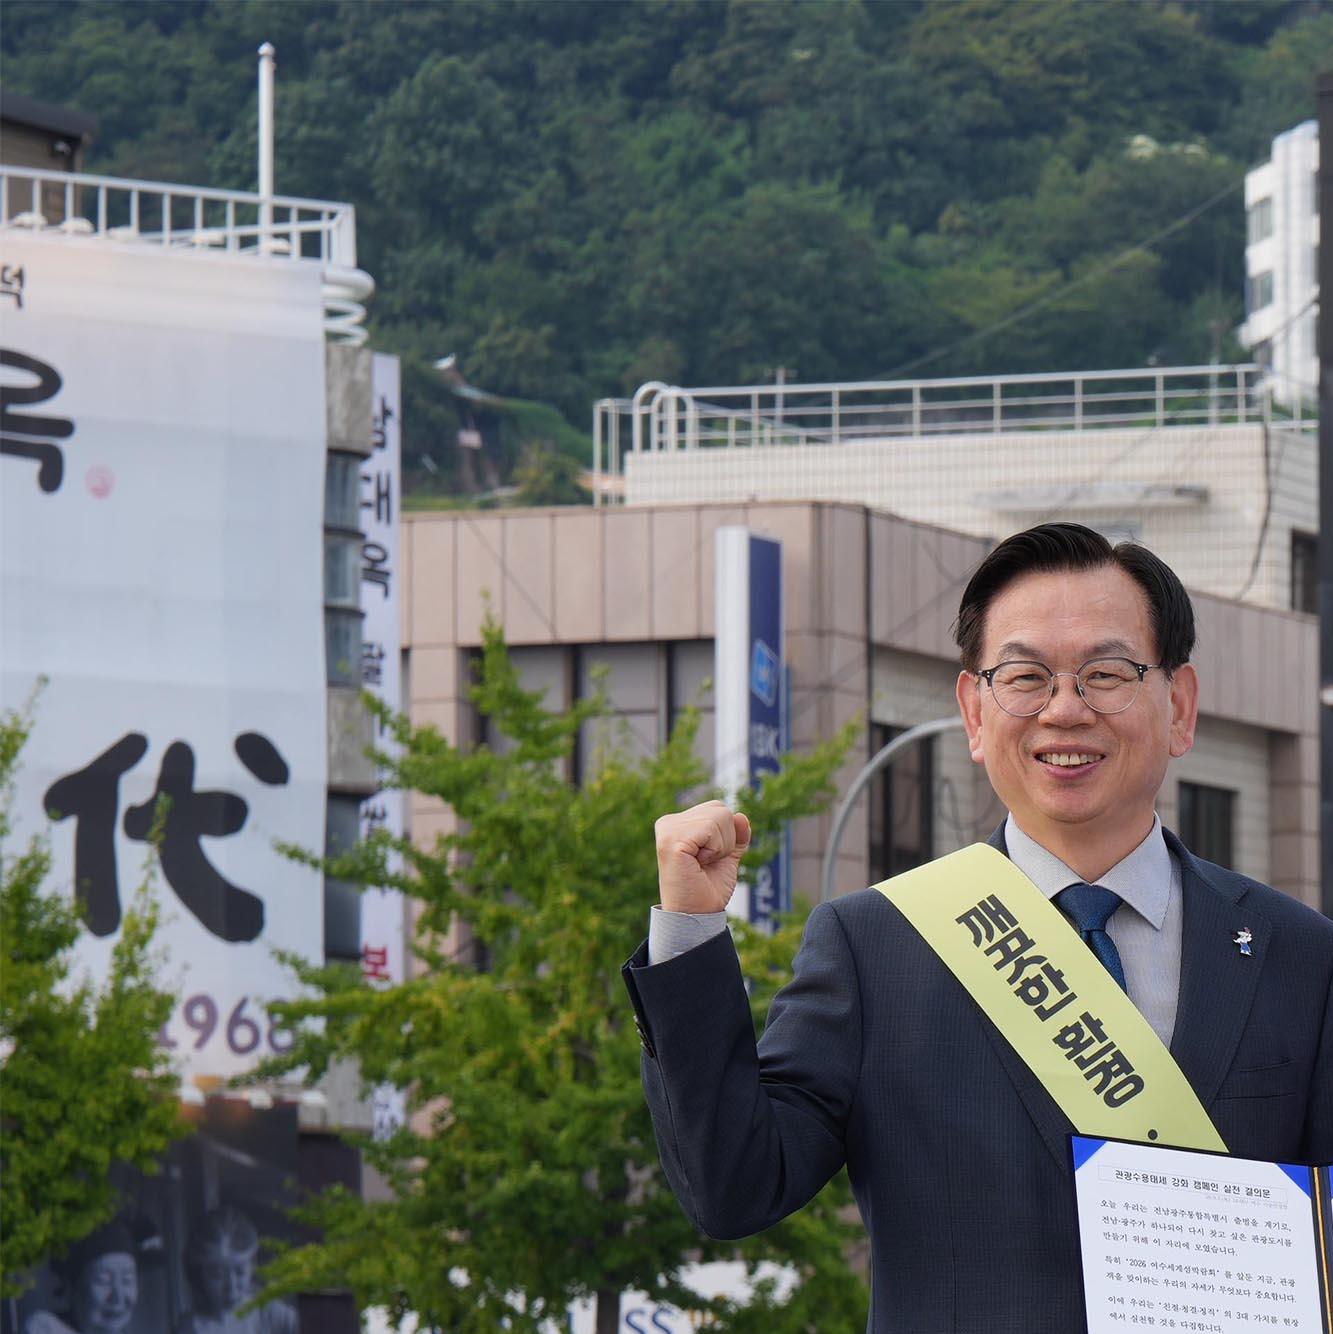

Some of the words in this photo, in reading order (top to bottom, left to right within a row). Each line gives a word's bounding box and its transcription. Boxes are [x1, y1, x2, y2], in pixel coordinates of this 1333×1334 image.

[43, 730, 290, 944] 代
[954, 894, 1078, 1022] 깨끗한
[1052, 1011, 1145, 1108] 환경
[1114, 1169, 1167, 1185] 관광수용태세
[1171, 1174, 1189, 1188] 강화
[1192, 1180, 1219, 1192] 캠페인
[1222, 1184, 1240, 1194] 실천
[1244, 1186, 1270, 1198] 결의문
[1100, 1199, 1116, 1208] 오늘
[1122, 1202, 1148, 1212] 우리는
[1153, 1206, 1228, 1223] 전남광주통합특별시
[1233, 1216, 1258, 1227] 출범을
[1102, 1231, 1128, 1242] 만들기
[1132, 1235, 1148, 1244] 위해
[1152, 1237, 1161, 1245] 이
[1165, 1239, 1190, 1249] 자리에
[1194, 1243, 1237, 1255] 모였습니다.
[1150, 1221, 1183, 1232] 하나되어
[1187, 1226, 1204, 1235] 다시
[1209, 1229, 1226, 1238] 찾고
[1229, 1231, 1247, 1241] 싶은
[1251, 1234, 1292, 1247] 관광도시를
[1105, 1271, 1123, 1280] 객을
[1126, 1273, 1159, 1285] 맞이하는
[1162, 1278, 1187, 1288] 우리의
[1190, 1282, 1215, 1292] 자세가
[1218, 1285, 1251, 1297] 무엇보다
[1254, 1290, 1296, 1302] 중요합니다.
